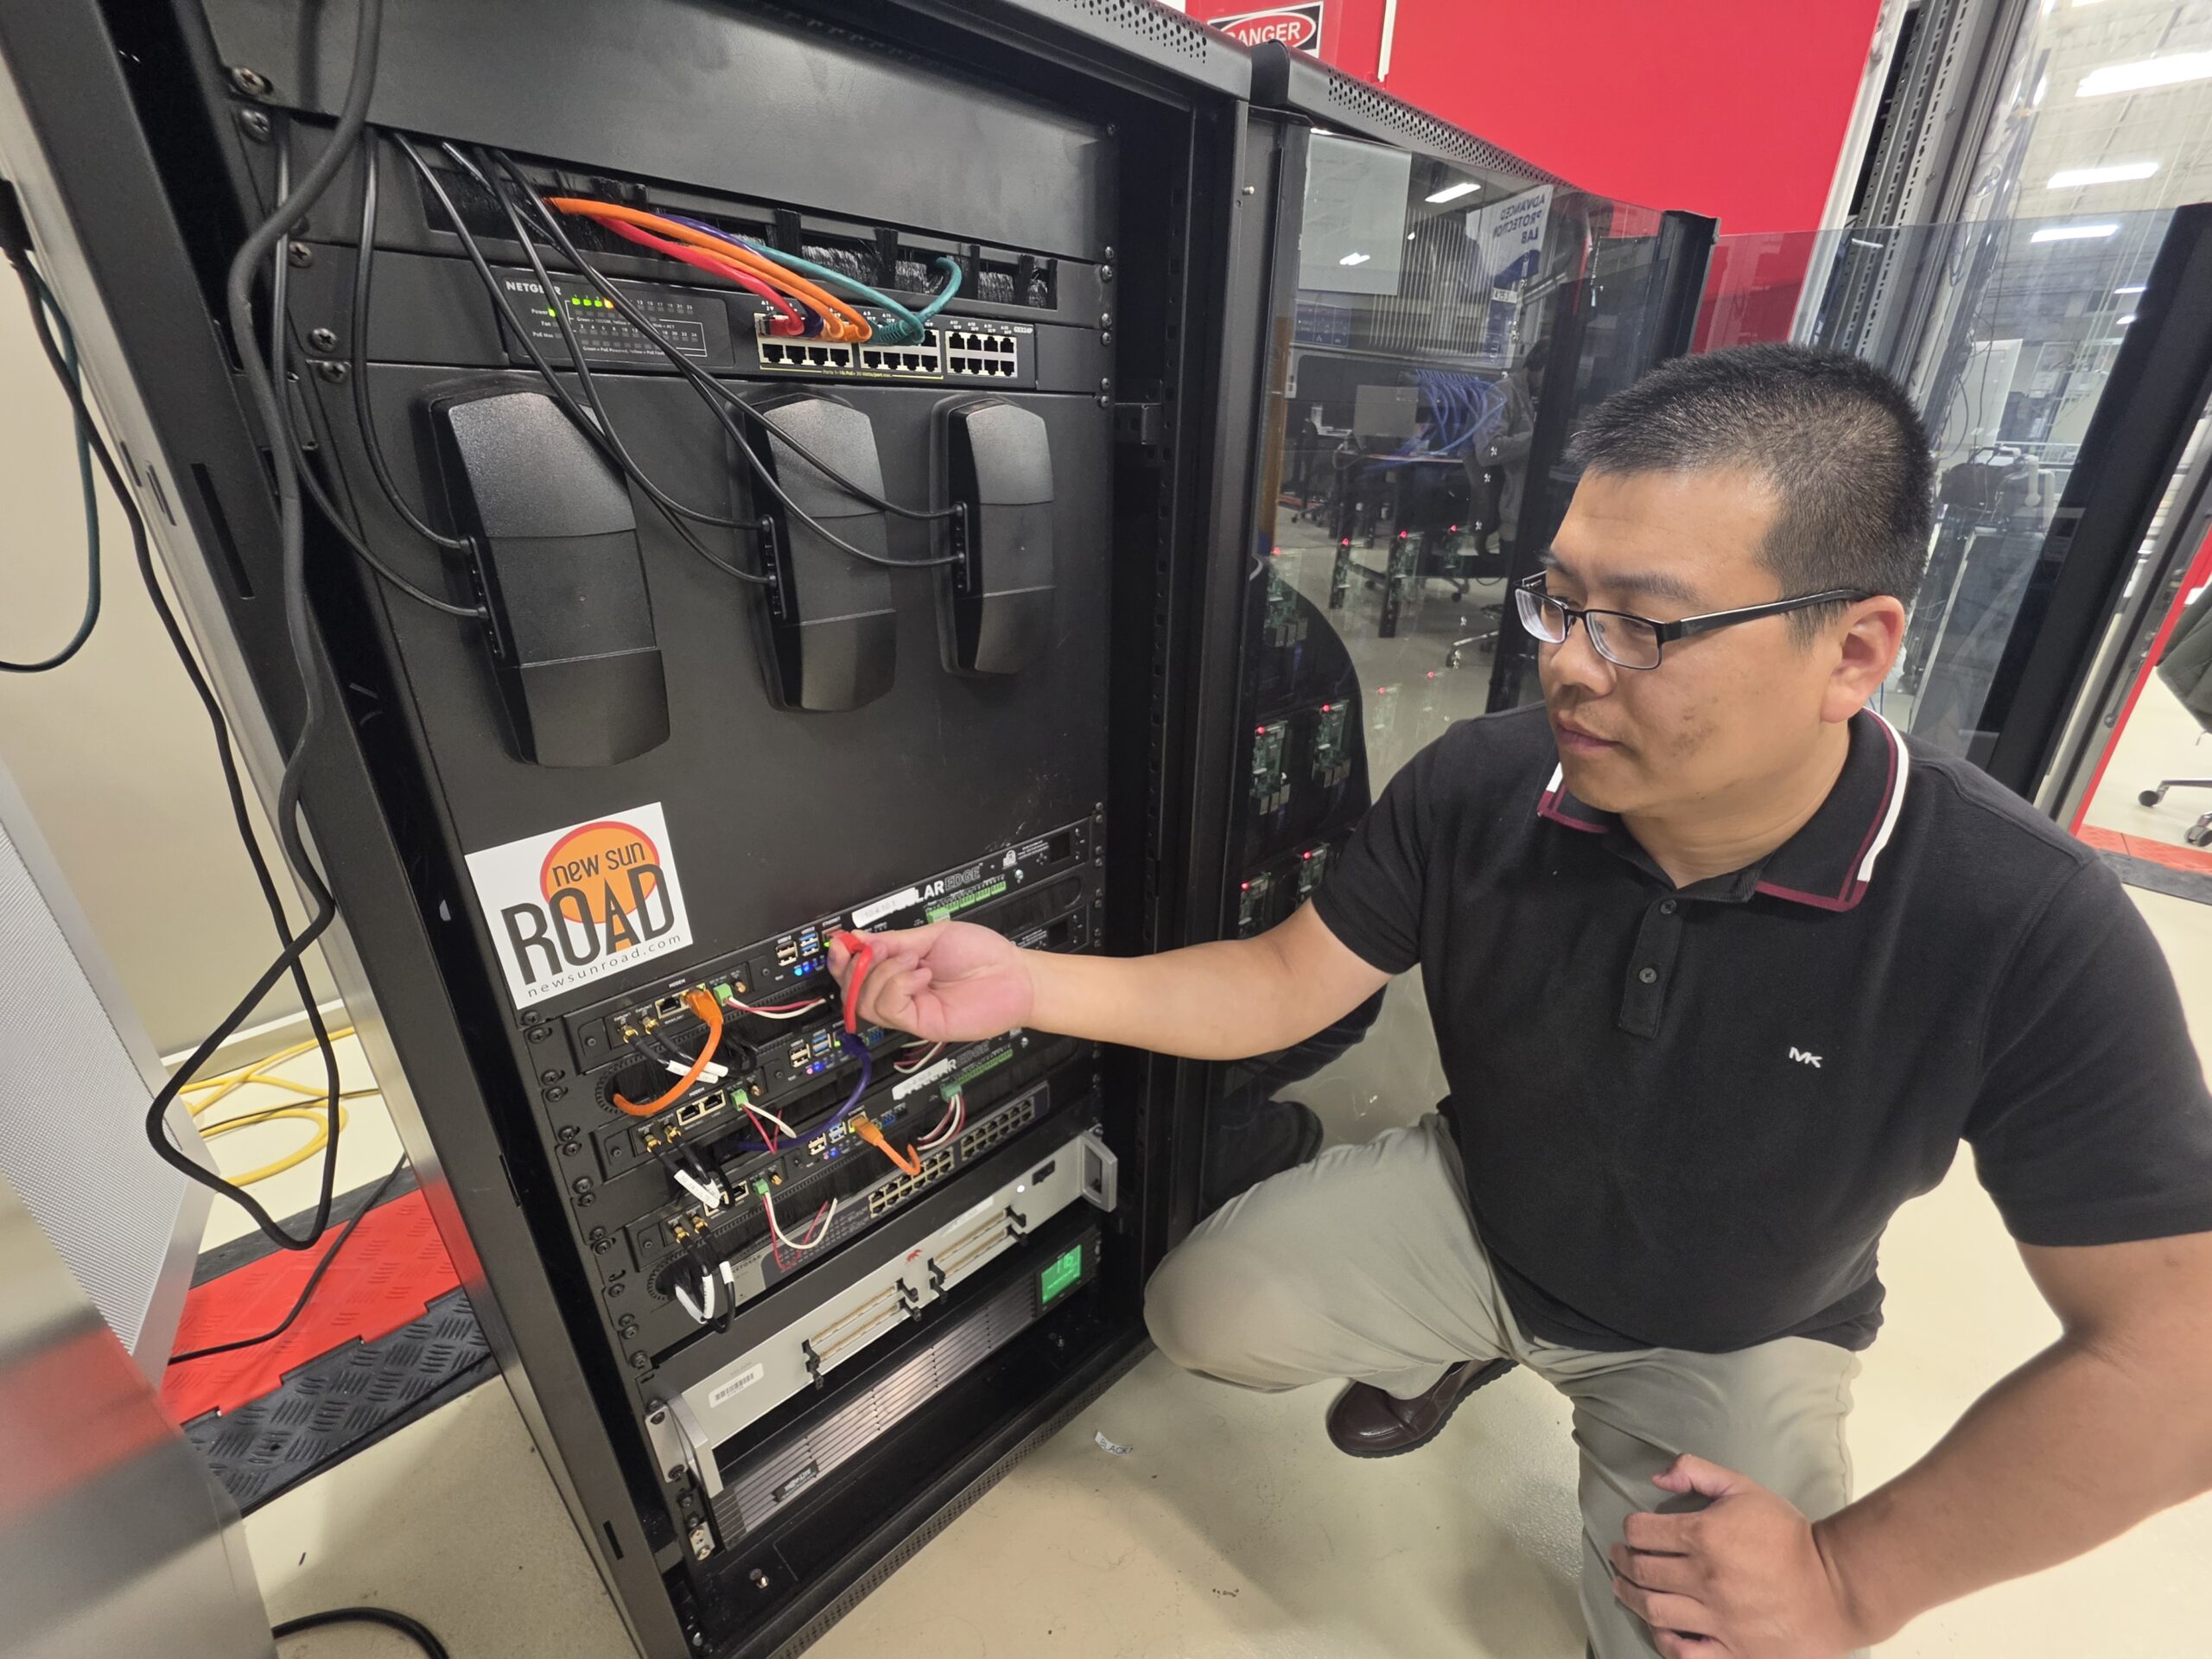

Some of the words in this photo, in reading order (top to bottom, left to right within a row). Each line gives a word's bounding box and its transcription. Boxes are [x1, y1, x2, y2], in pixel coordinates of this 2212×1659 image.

[505, 281, 562, 296] NETGR
[552, 855, 599, 887] new
[605, 842, 645, 870] sun
[500, 863, 675, 985] ROAD
[527, 933, 681, 998] newsunroad.com
[1789, 1046, 1823, 1068] MK
